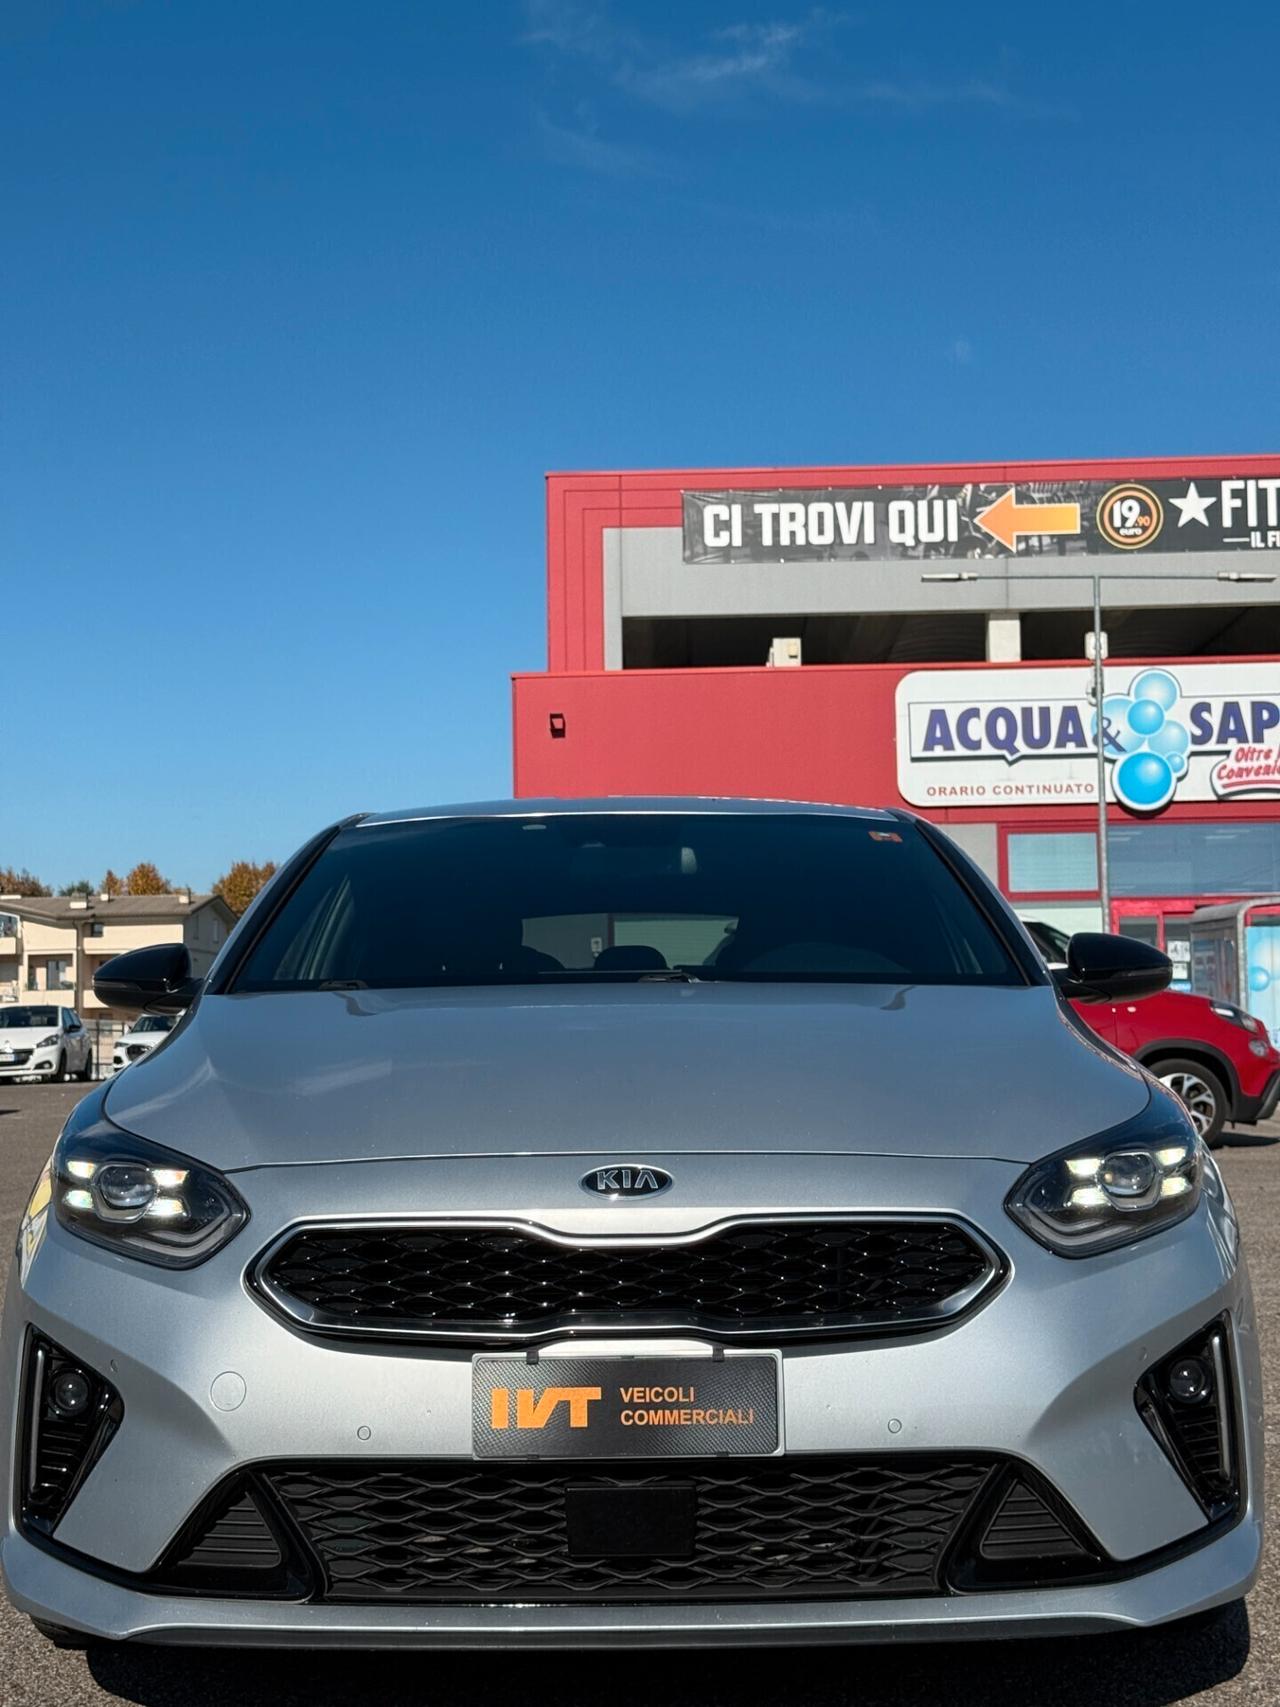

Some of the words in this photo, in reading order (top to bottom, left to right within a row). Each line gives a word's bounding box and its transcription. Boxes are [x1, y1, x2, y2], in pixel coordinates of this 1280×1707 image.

[703, 503, 742, 547] CI
[754, 501, 874, 546] TROVI
[888, 499, 958, 547] QUI
[1251, 531, 1265, 548] IL
[922, 705, 1088, 756] ACQUA
[1190, 701, 1280, 745] SAP
[1234, 746, 1273, 763] Oltre
[927, 785, 986, 797] ORARIO
[992, 783, 1095, 796] CONTINUATO
[597, 1169, 659, 1190] KIA
[620, 1387, 695, 1403] VEICOLI
[620, 1408, 755, 1427] COMMERCIALI
